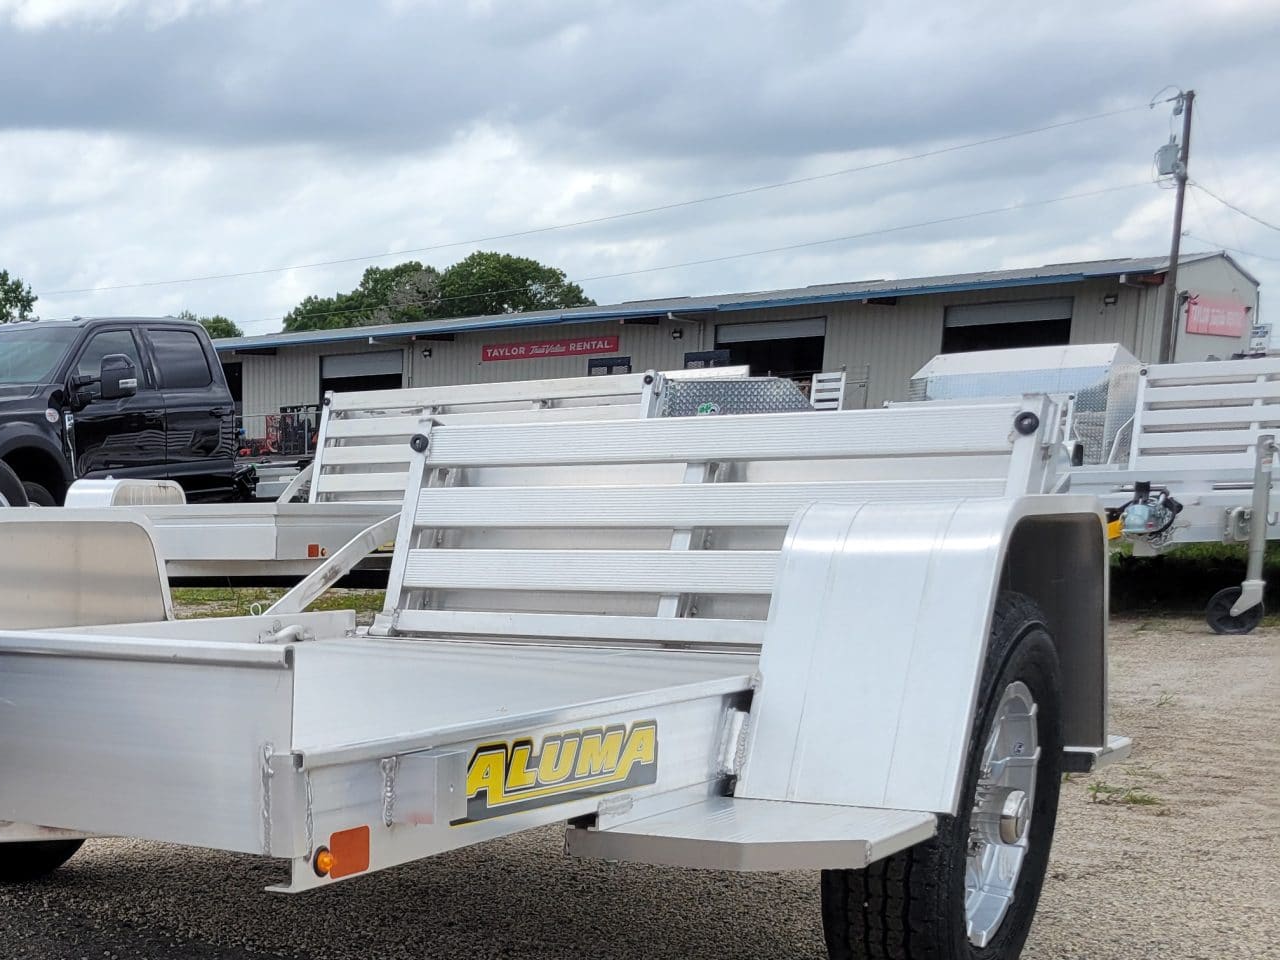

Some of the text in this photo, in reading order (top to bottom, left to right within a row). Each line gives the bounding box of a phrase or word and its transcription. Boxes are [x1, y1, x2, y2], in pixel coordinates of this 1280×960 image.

[486, 346, 526, 357] TAYLOR
[569, 340, 611, 352] RENTAL
[467, 723, 656, 809] ALUMA
